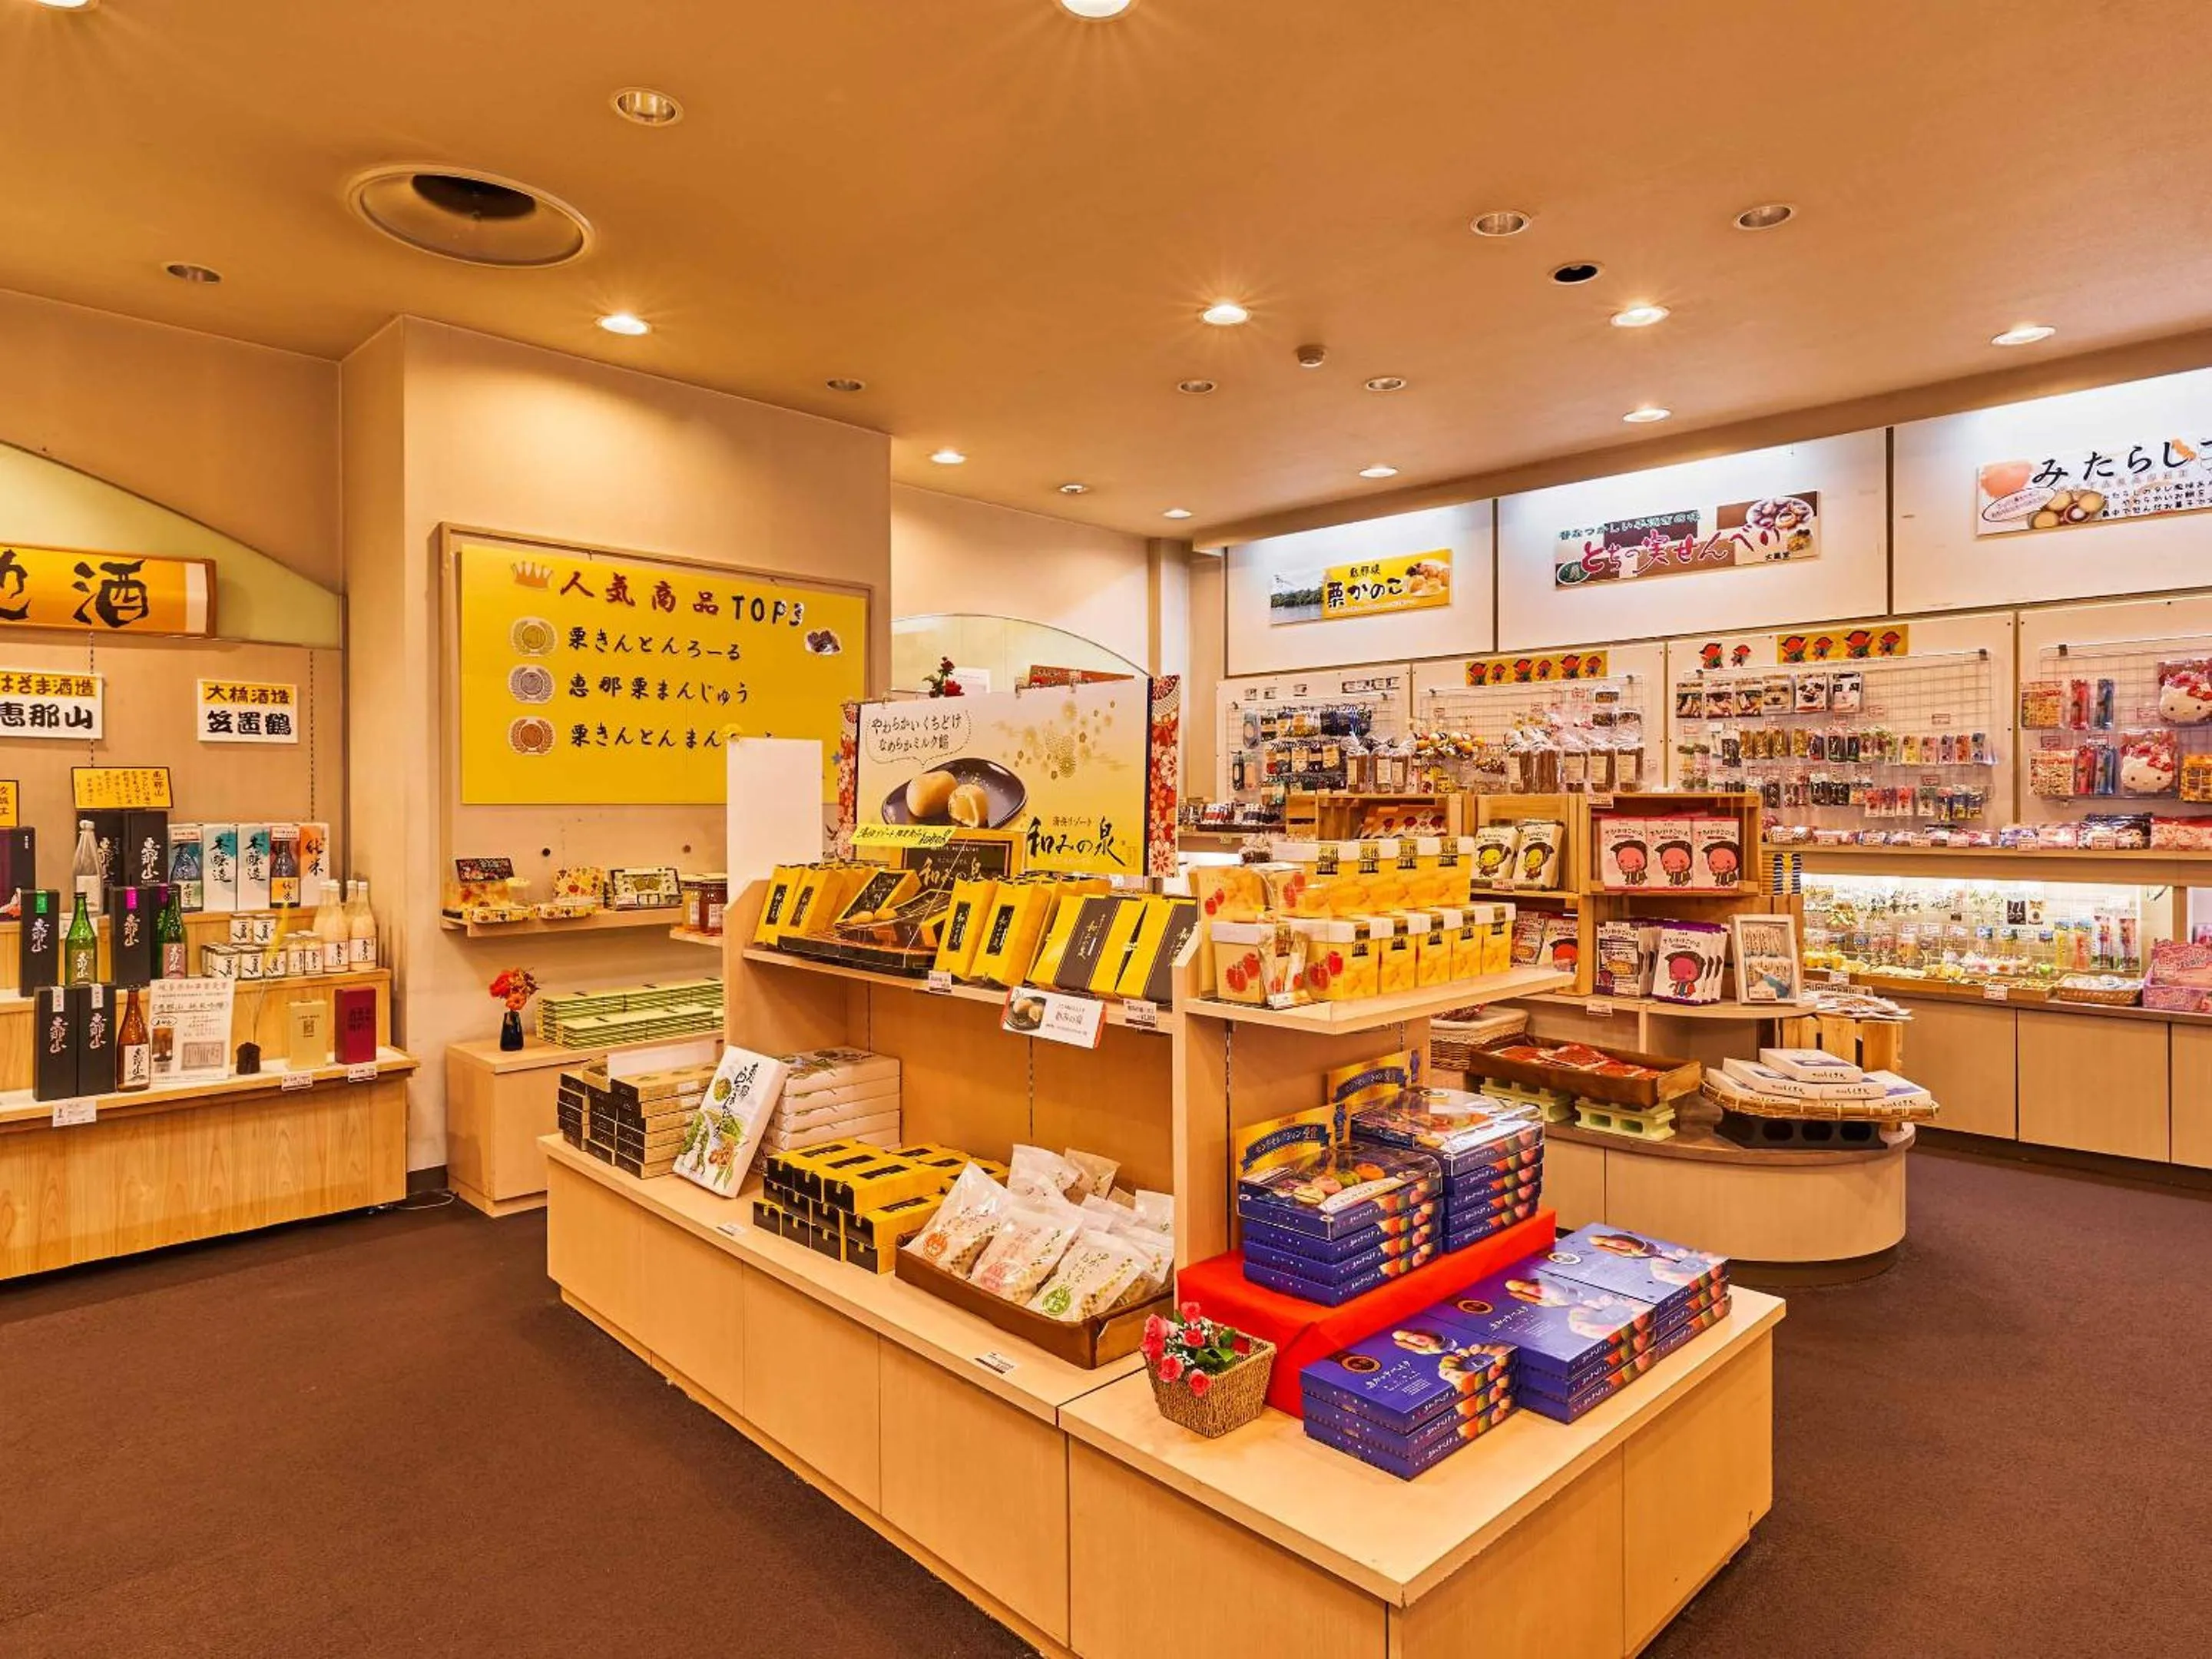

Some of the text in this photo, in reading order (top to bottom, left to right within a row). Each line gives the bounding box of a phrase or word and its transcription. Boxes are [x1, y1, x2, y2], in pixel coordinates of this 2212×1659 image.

[1327, 578, 1402, 608] 栗かのこ
[569, 627, 742, 661] 栗きんとんろーる
[205, 684, 290, 704] 大橋酒造
[569, 673, 748, 704] 恵那栗まんじゅう
[0, 701, 93, 729] 恵那山
[571, 724, 773, 749] 栗きんとんまん
[1027, 816, 1127, 866] 和みの泉
